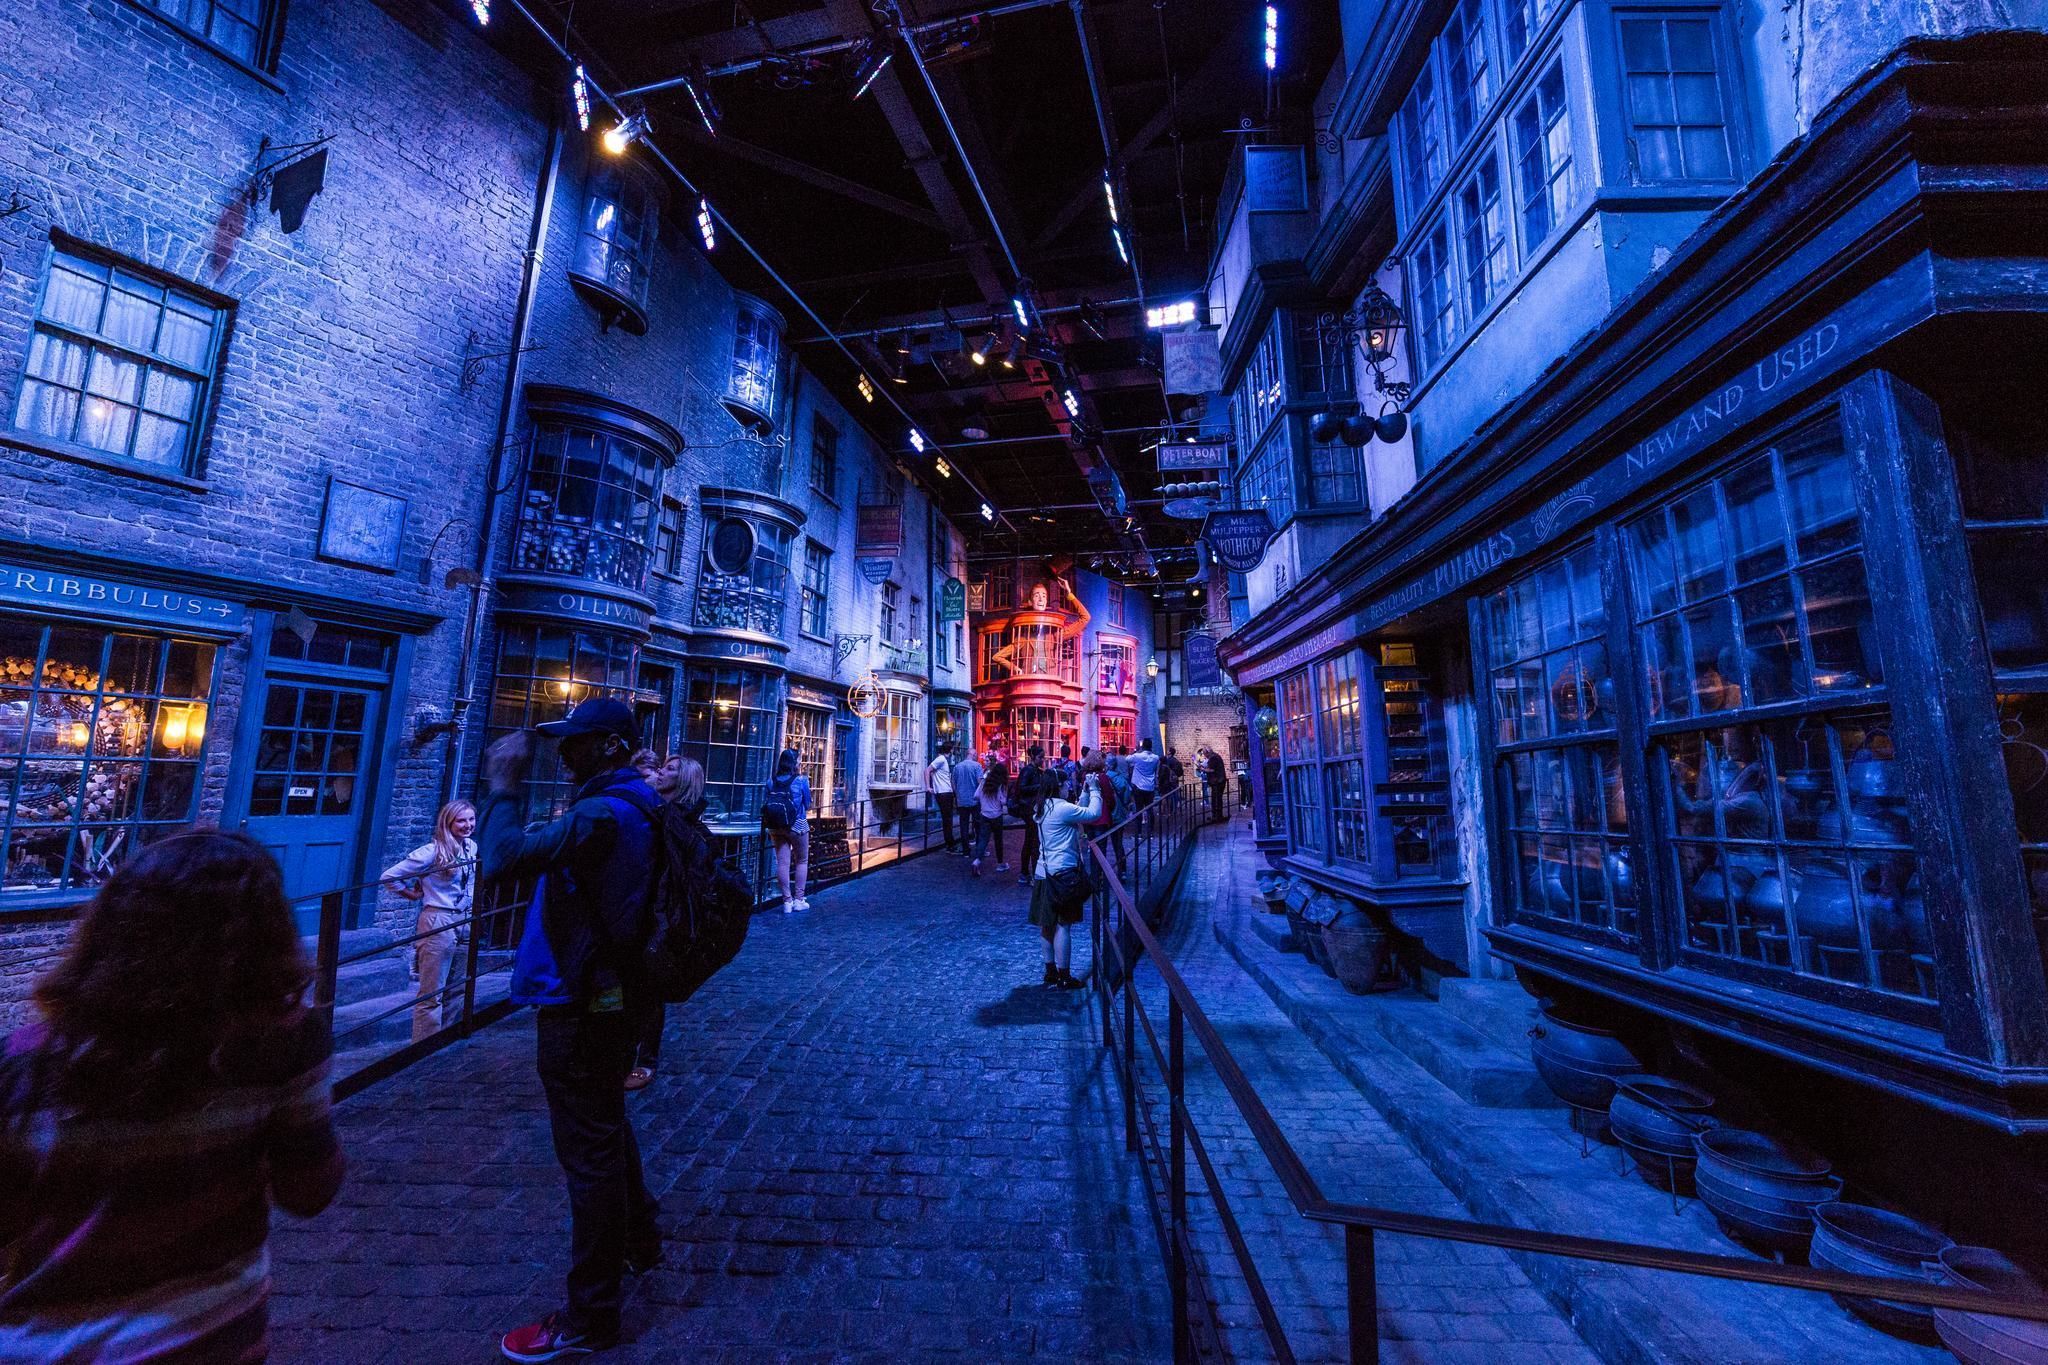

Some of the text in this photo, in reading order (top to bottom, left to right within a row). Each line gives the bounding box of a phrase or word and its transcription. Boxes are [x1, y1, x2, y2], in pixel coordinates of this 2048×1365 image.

[1625, 323, 1840, 478] NEW AND USED
[1195, 447, 1222, 462] BOAT
[1387, 578, 1425, 610] QUALITY
[1434, 530, 1516, 593] POTAGES
